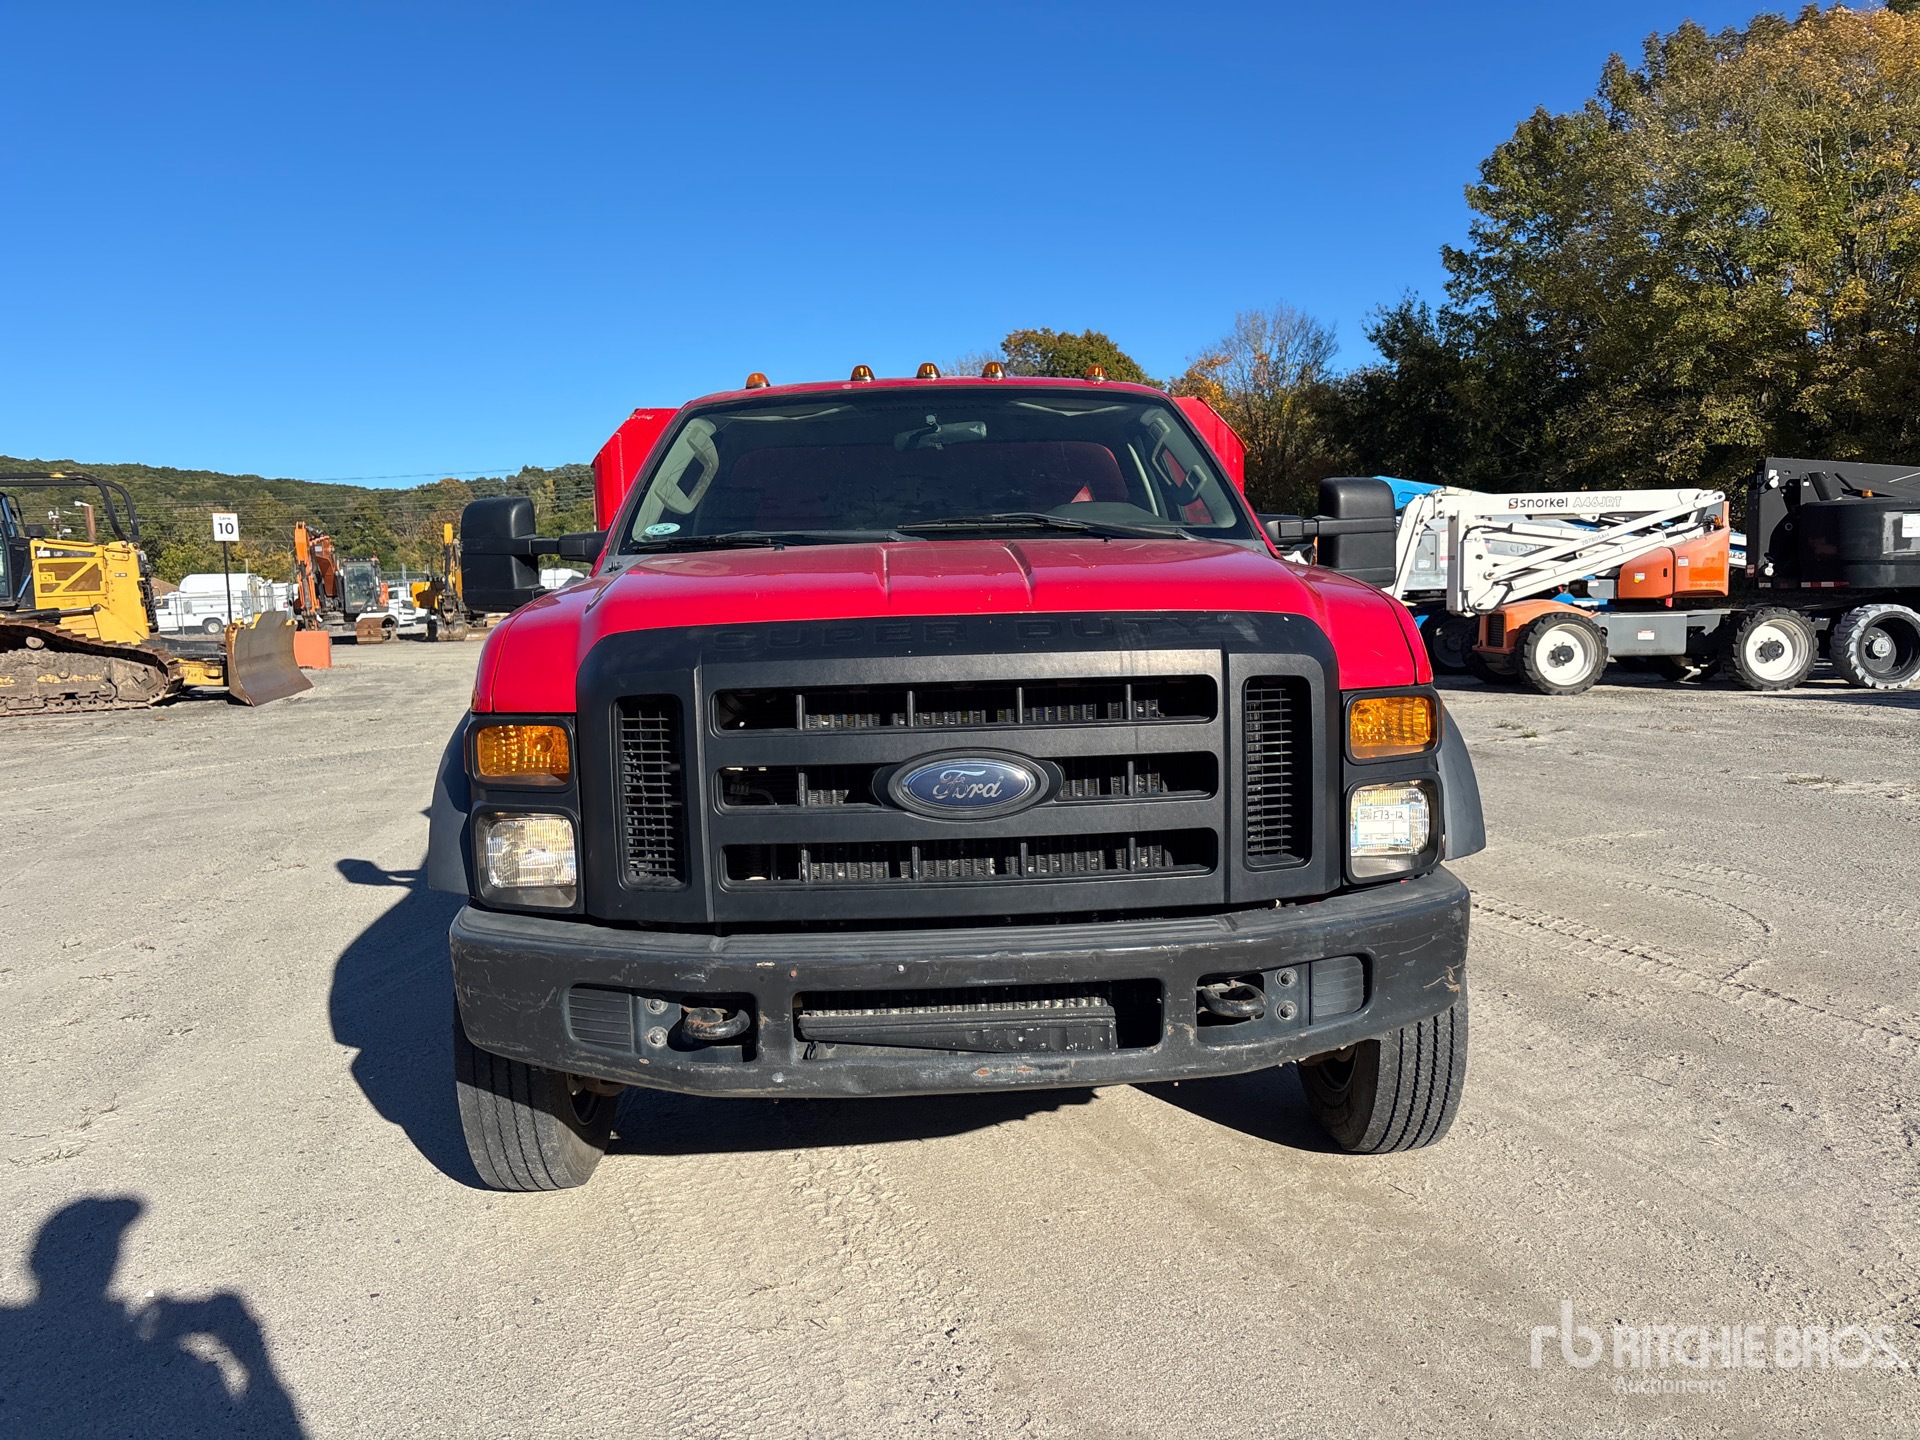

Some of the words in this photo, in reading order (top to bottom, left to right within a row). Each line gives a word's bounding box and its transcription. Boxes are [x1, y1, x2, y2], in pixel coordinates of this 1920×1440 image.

[1520, 497, 1568, 508] snorkel
[1572, 496, 1622, 508] A46JRT
[217, 522, 234, 534] 10
[713, 621, 968, 651] SUPER
[1015, 617, 1211, 640] DUTY
[932, 769, 1004, 800] Ford
